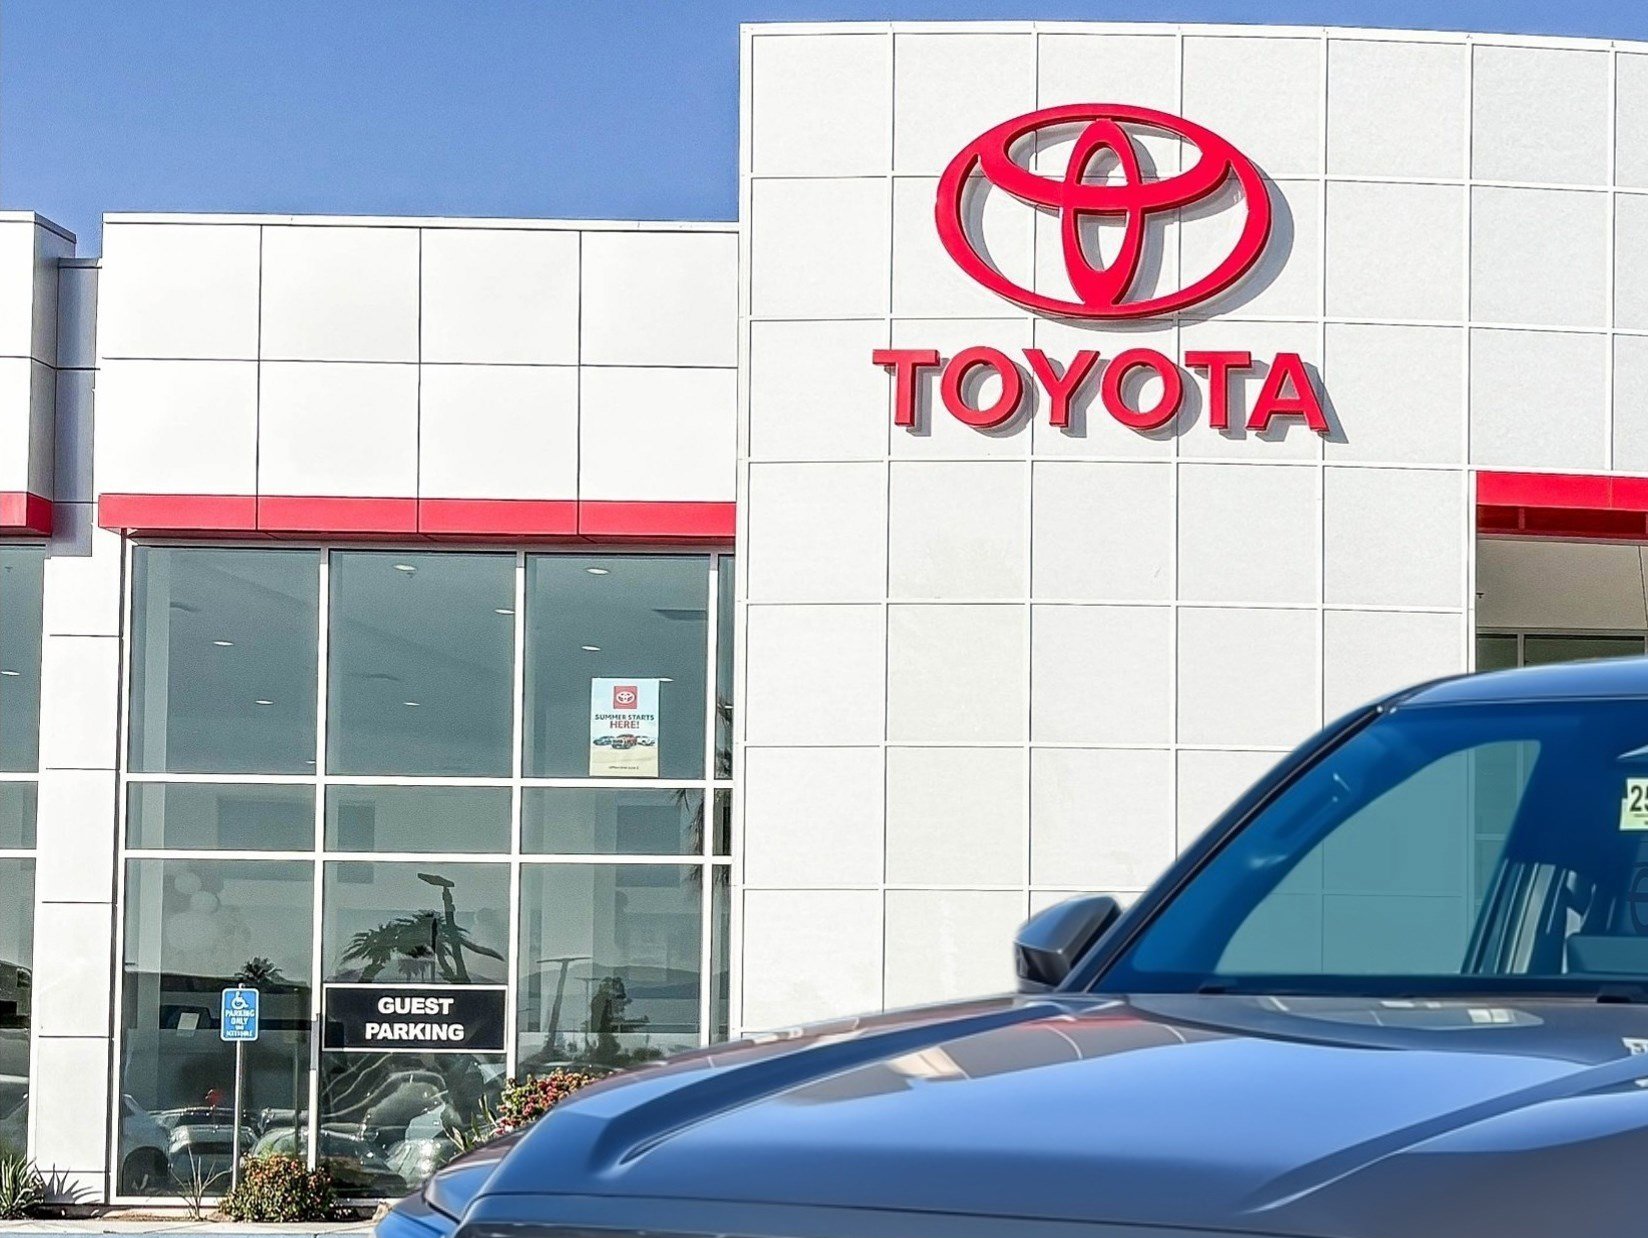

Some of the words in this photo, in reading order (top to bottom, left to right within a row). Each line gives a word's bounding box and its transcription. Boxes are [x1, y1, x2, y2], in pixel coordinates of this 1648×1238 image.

[873, 346, 1331, 434] TOYOTA
[609, 720, 640, 729] HERE!
[377, 996, 455, 1015] GUEST
[365, 1022, 465, 1041] PARKING
